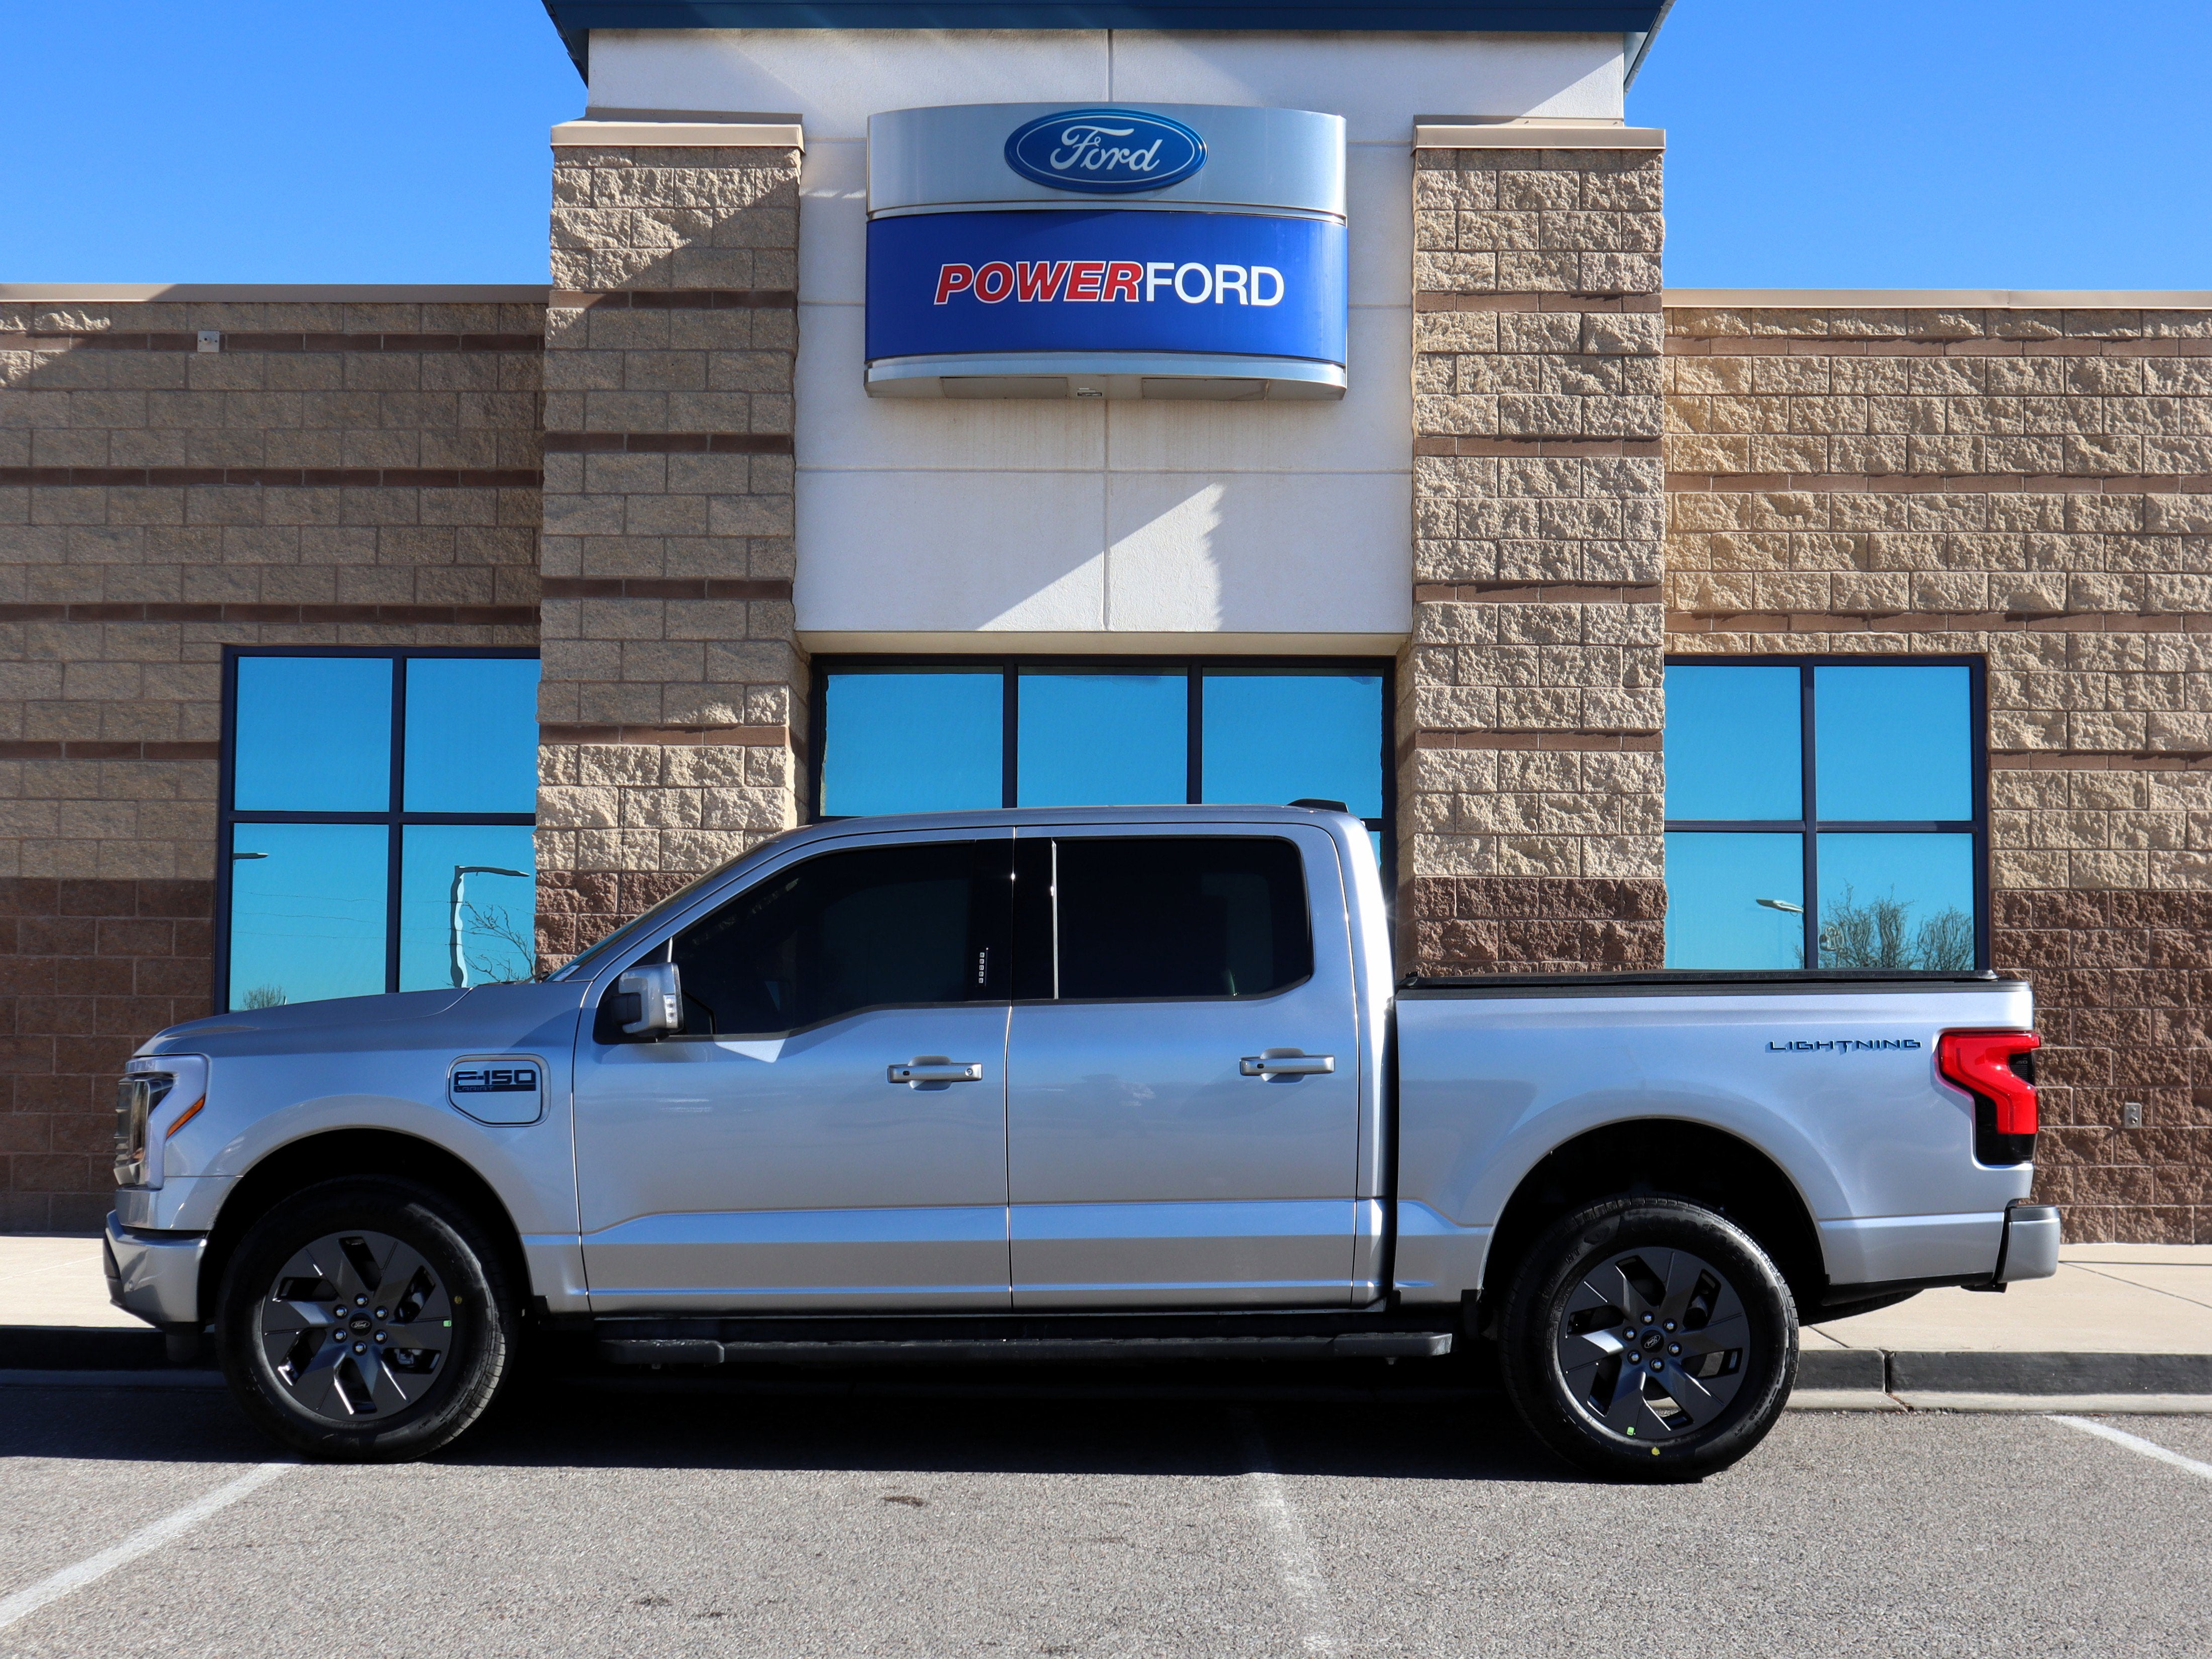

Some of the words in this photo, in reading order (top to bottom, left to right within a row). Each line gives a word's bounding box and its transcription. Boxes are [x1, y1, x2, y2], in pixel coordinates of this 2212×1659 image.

[1049, 124, 1164, 172] Ford
[1769, 1038, 1922, 1053] LIGHTNING
[454, 1070, 536, 1085] F-150
